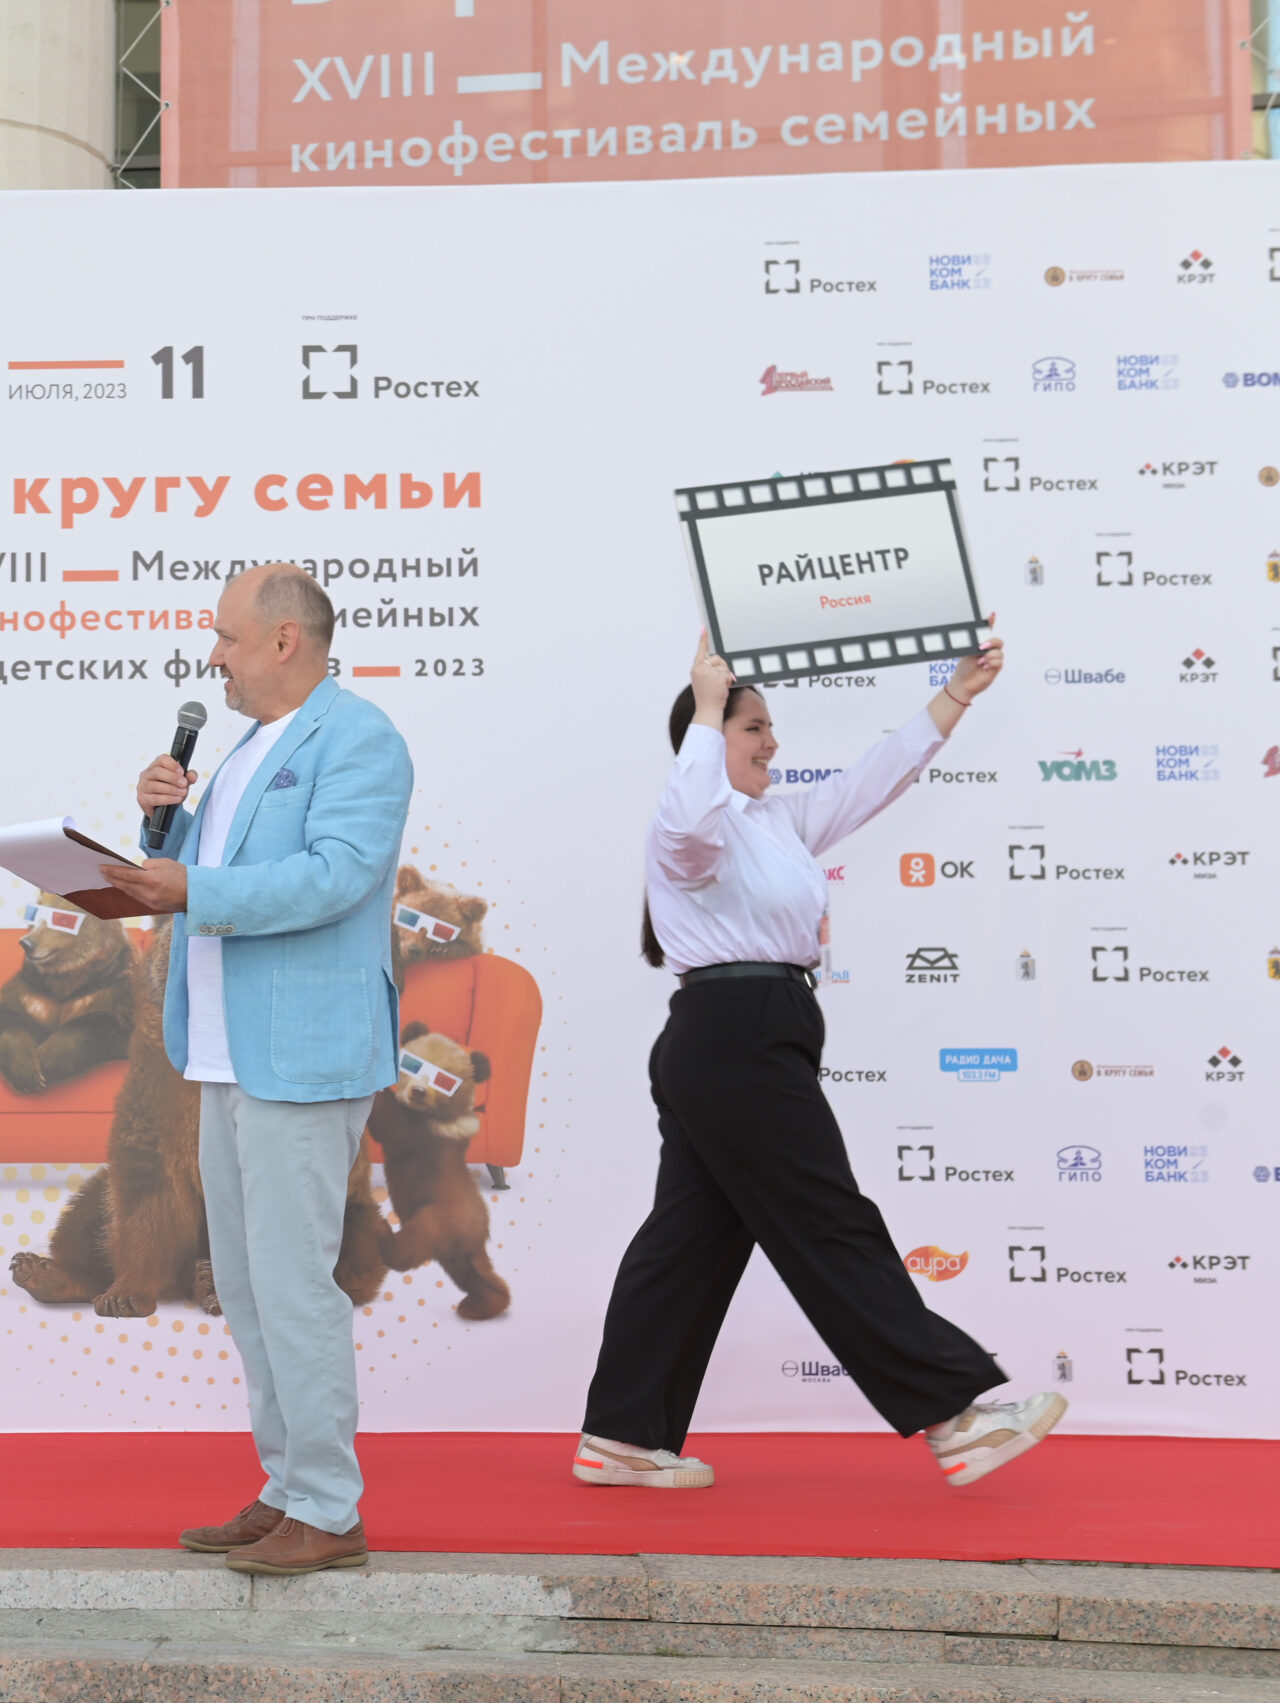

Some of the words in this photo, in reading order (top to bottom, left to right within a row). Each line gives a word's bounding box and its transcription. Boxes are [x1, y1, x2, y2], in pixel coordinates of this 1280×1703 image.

[292, 51, 434, 103] XVIII
[560, 12, 1095, 88] Международный
[292, 119, 758, 174] кинофестиваль
[781, 94, 1096, 148] семейных
[810, 279, 876, 293] Ростех
[151, 346, 204, 399] 11
[9, 384, 78, 401] ИЮЛЯ,
[83, 383, 127, 399] 2023
[374, 376, 479, 398] Ростех
[923, 380, 990, 394] Ростех
[1163, 461, 1217, 475] КРЭТ
[1030, 477, 1097, 491] Ростех
[14, 476, 230, 529] кругу
[254, 472, 481, 511] семьи
[758, 548, 909, 586] РАЙЦЕНТР
[1143, 571, 1211, 586] Ростех
[820, 595, 872, 609] Россия
[415, 658, 484, 676] 2023
[1065, 669, 1125, 684] Швабе
[1180, 672, 1218, 683] КРЭТ
[785, 768, 843, 783] ВОМ
[930, 769, 997, 783] Ростех
[1038, 757, 1117, 781] УОМЗ
[1193, 852, 1249, 866] КРЭТ
[1056, 865, 1124, 880] Ростех
[906, 974, 960, 983] ZENIT
[1139, 967, 1208, 982] Ростех
[945, 1054, 979, 1066] РАДИО
[983, 1054, 1011, 1065] ДАЧА
[819, 1068, 887, 1082] Ростех
[945, 1167, 1014, 1181] Ростех
[906, 1253, 961, 1277] аура
[1193, 1256, 1250, 1270] КРЭТ
[1057, 1267, 1126, 1283] Ростех
[802, 1361, 850, 1377] Шва
[1175, 1370, 1246, 1386] Ростех
